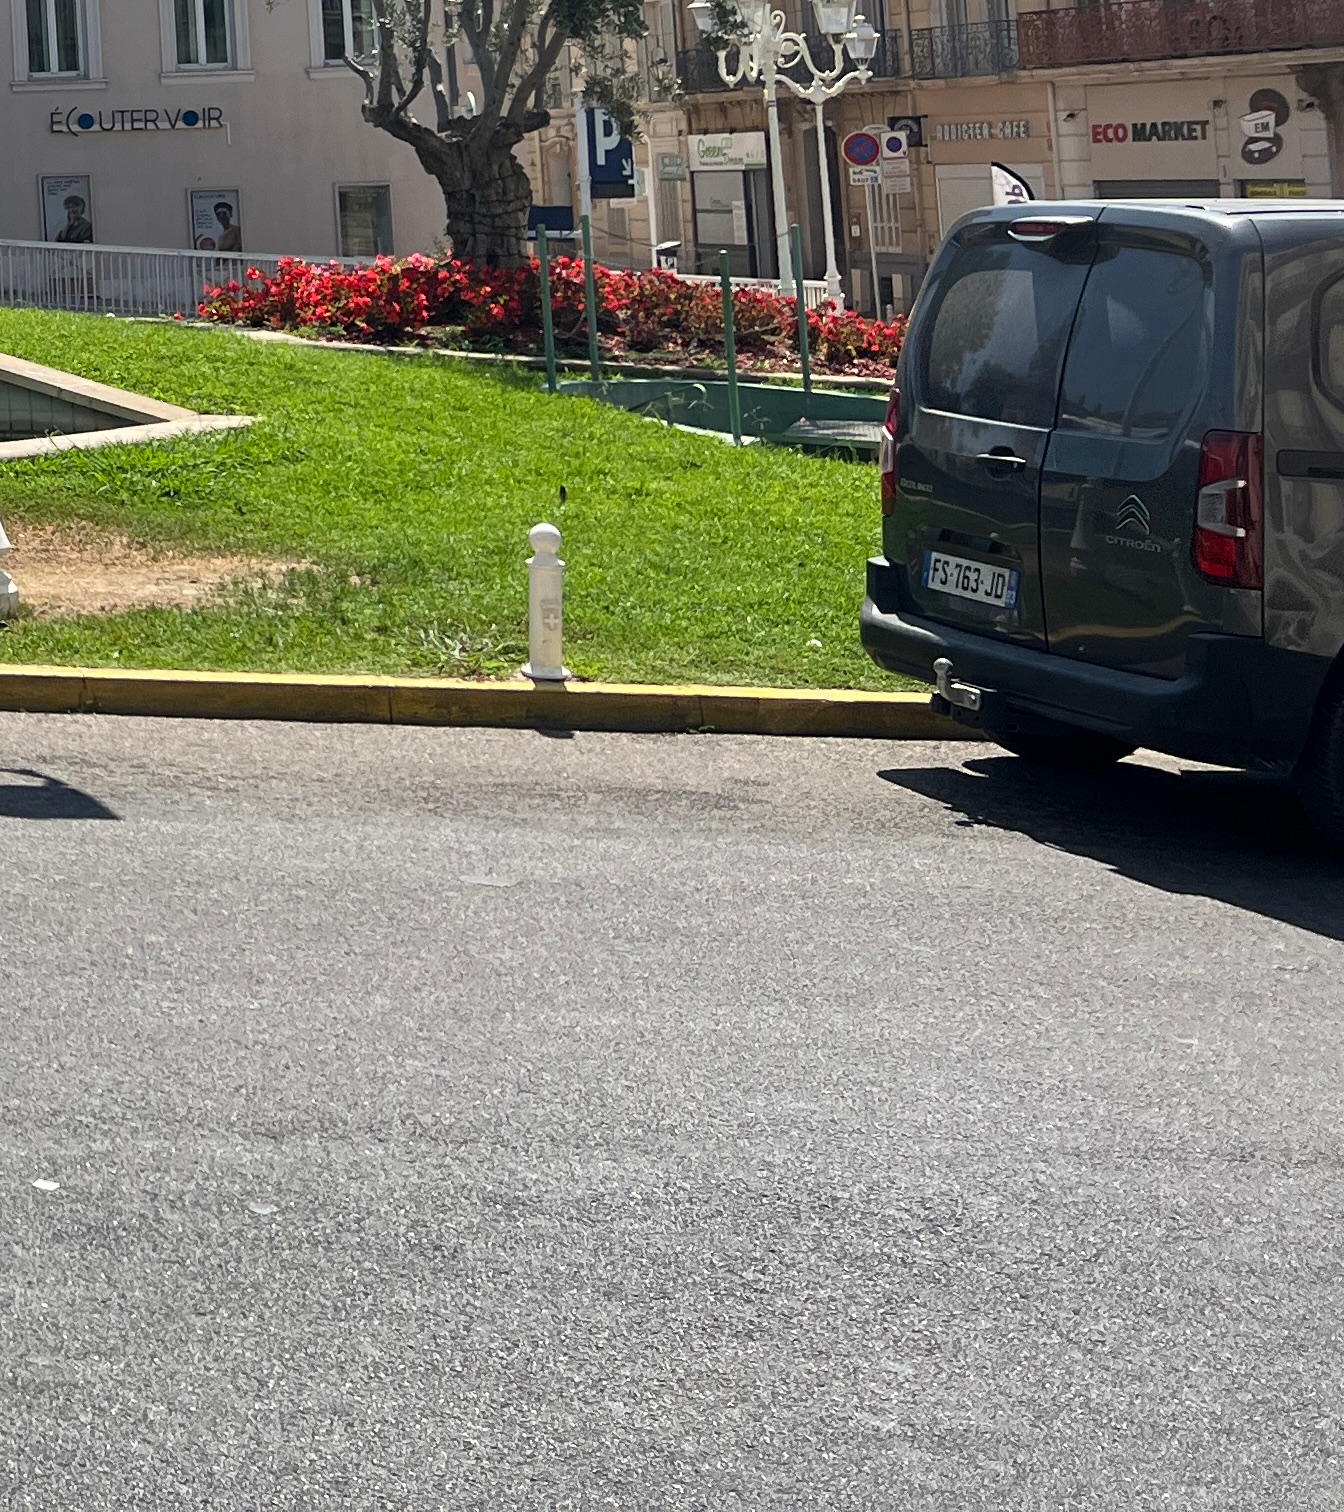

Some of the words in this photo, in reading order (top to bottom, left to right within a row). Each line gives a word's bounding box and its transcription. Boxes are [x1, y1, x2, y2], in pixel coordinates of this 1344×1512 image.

[594, 108, 622, 166] P
[1091, 123, 1128, 144] ECO
[1131, 120, 1210, 142] MARKET
[1254, 119, 1271, 134] EM
[931, 558, 1006, 600] FS-763-JD
